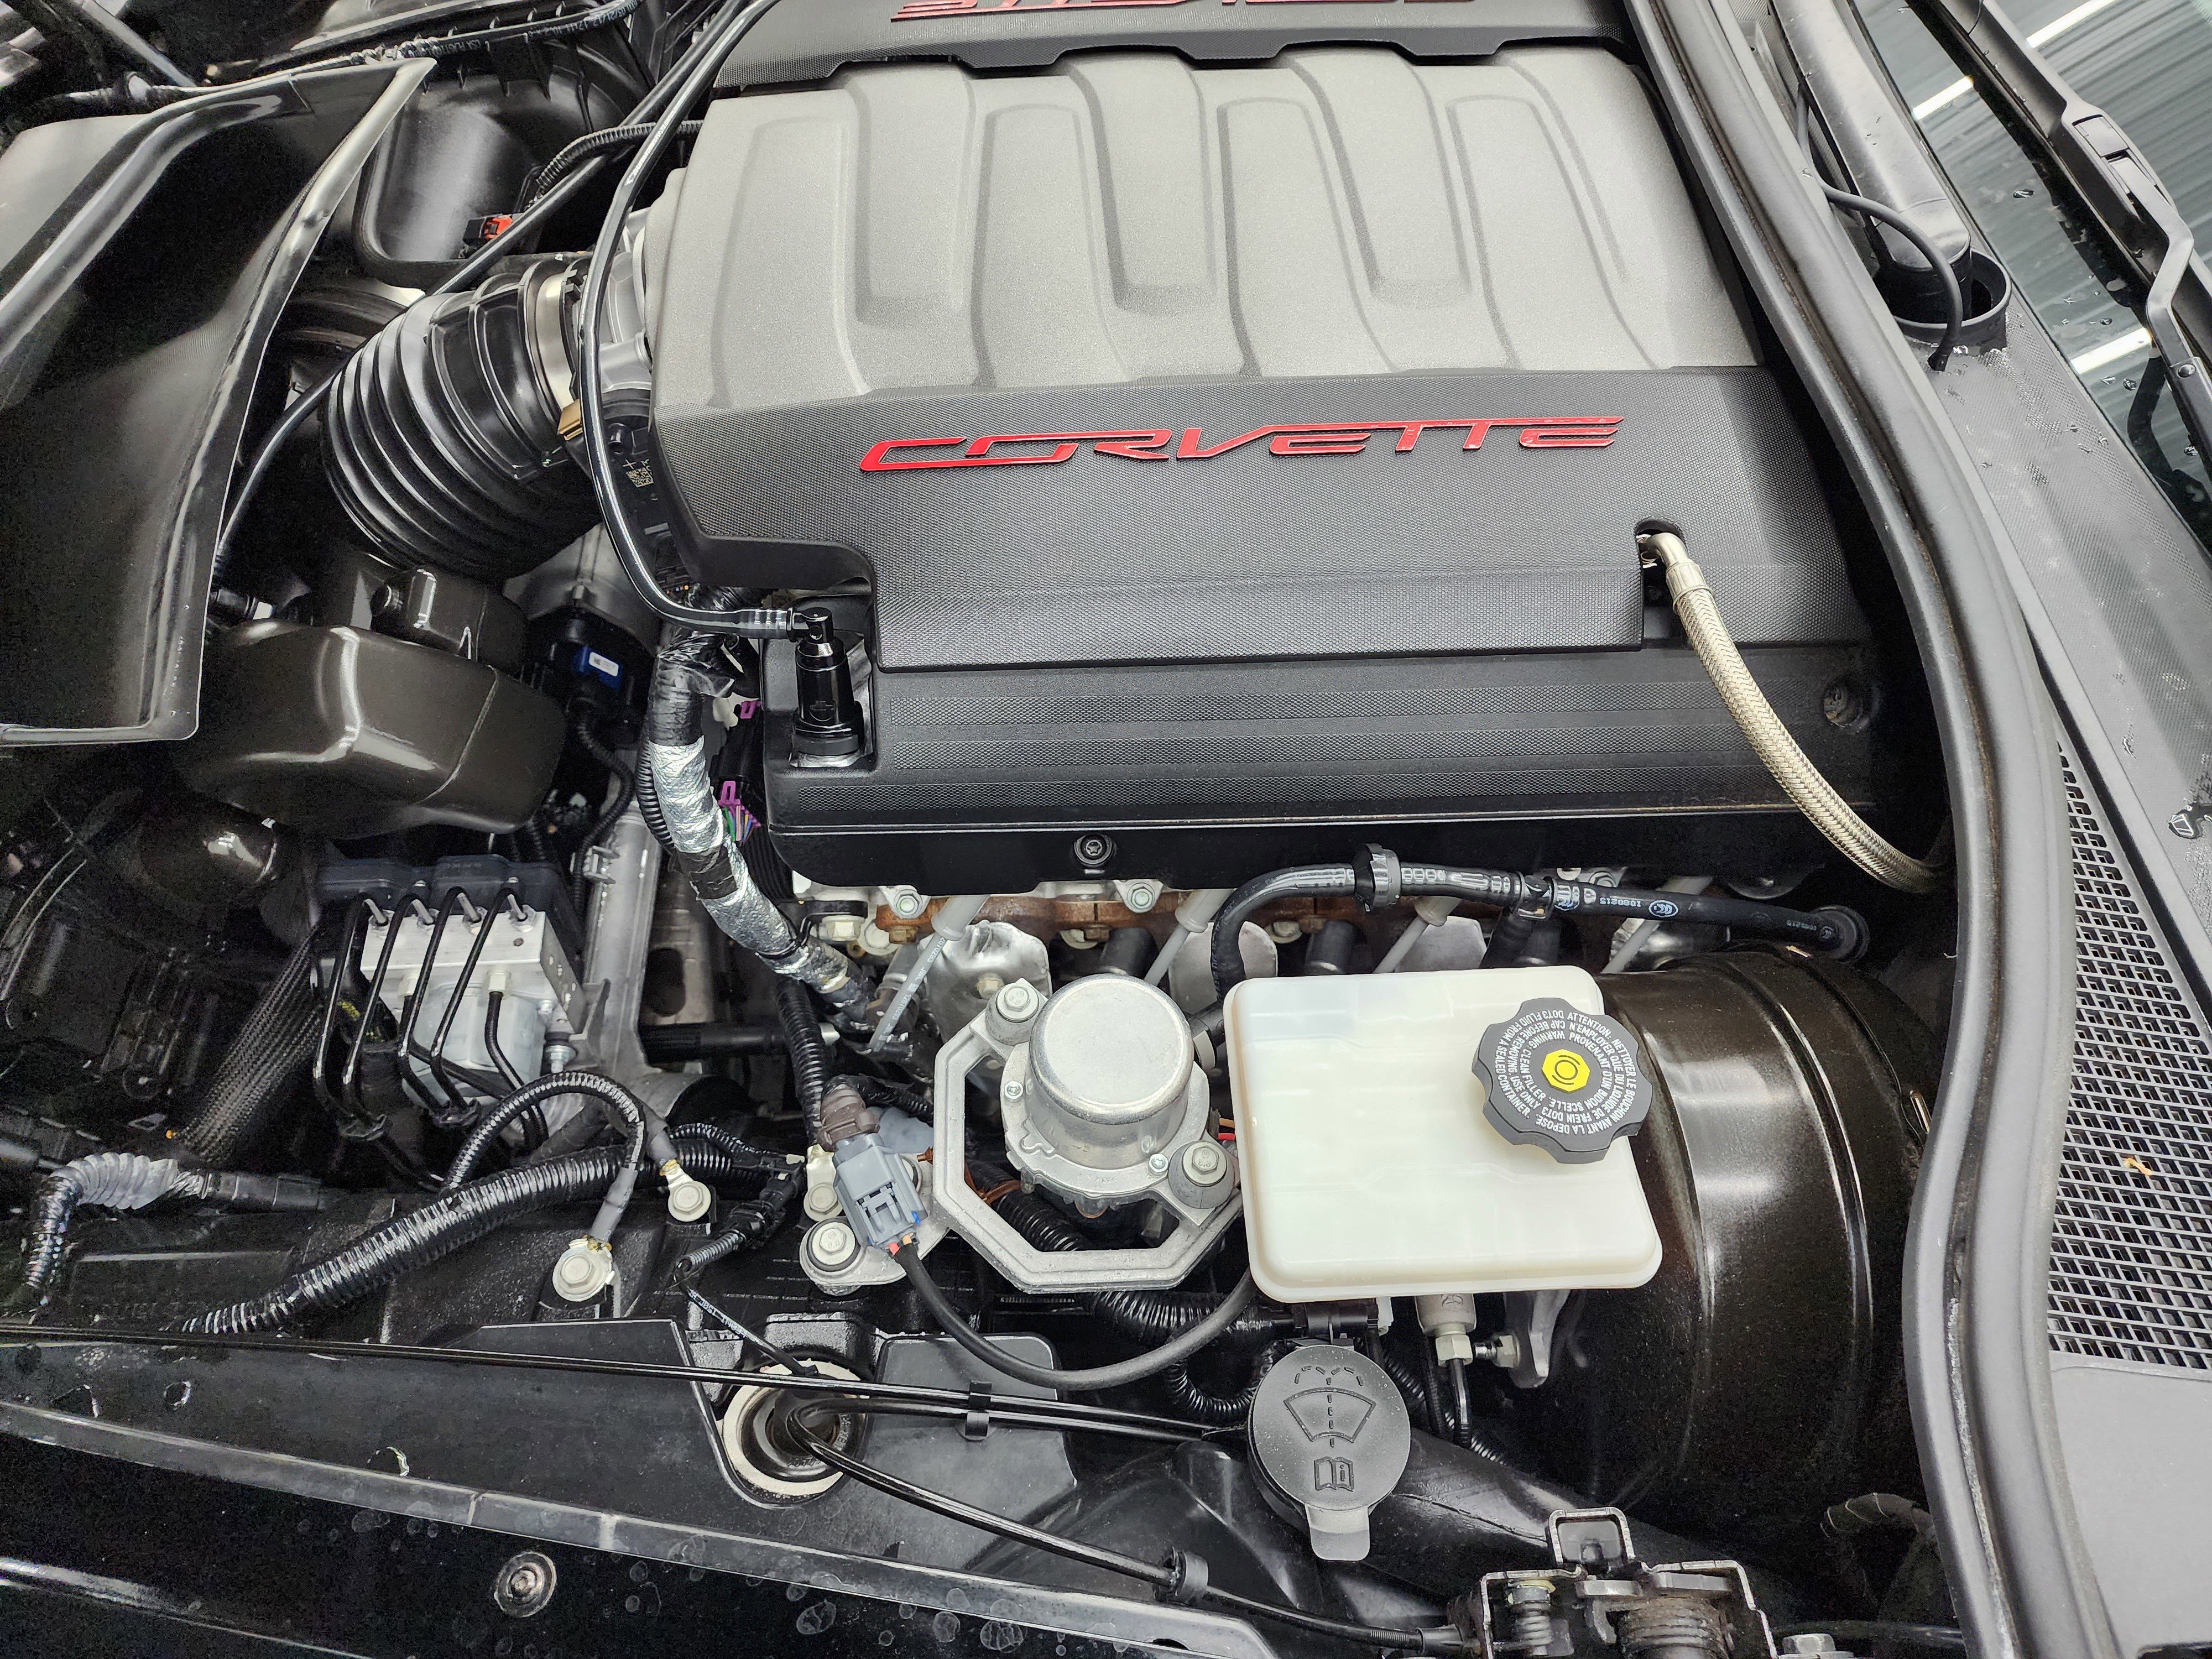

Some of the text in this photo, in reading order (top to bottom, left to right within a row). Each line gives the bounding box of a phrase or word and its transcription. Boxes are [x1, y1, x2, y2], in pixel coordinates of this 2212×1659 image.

[860, 416, 1625, 472] CORVETTE
[927, 937, 947, 964] 2670293
[1519, 1011, 1542, 1026] FLUID
[1541, 1010, 1564, 1019] DOT3
[1502, 1021, 1523, 1041] FROM
[1495, 1045, 1507, 1074] SEALED
[1569, 1032, 1611, 1069] PROVENANT
[1611, 1039, 1636, 1077] NETTOYER
[1507, 1020, 1566, 1109] CAP BEFORE REMOVING. USE ONLY
[1520, 1030, 1566, 1102] WARNING: CLEAN FILLER
[1610, 1055, 1624, 1072] QUE
[1600, 1071, 1613, 1090] D'UN
[1614, 1073, 1625, 1086] DU
[1626, 1078, 1637, 1089] LE
[1498, 1074, 1531, 1119] CONTAINER.
[1583, 1088, 1608, 1110] BIDON
[1601, 1084, 1624, 1113] LIQUIDE
[1609, 1089, 1636, 1123] BOUCHON
[1541, 1106, 1564, 1121] DOT3
[1566, 1112, 1593, 1123] FREIN
[1592, 1107, 1605, 1120] DE
[1572, 1124, 1585, 1134] LA
[1587, 1117, 1613, 1134] AVANT
